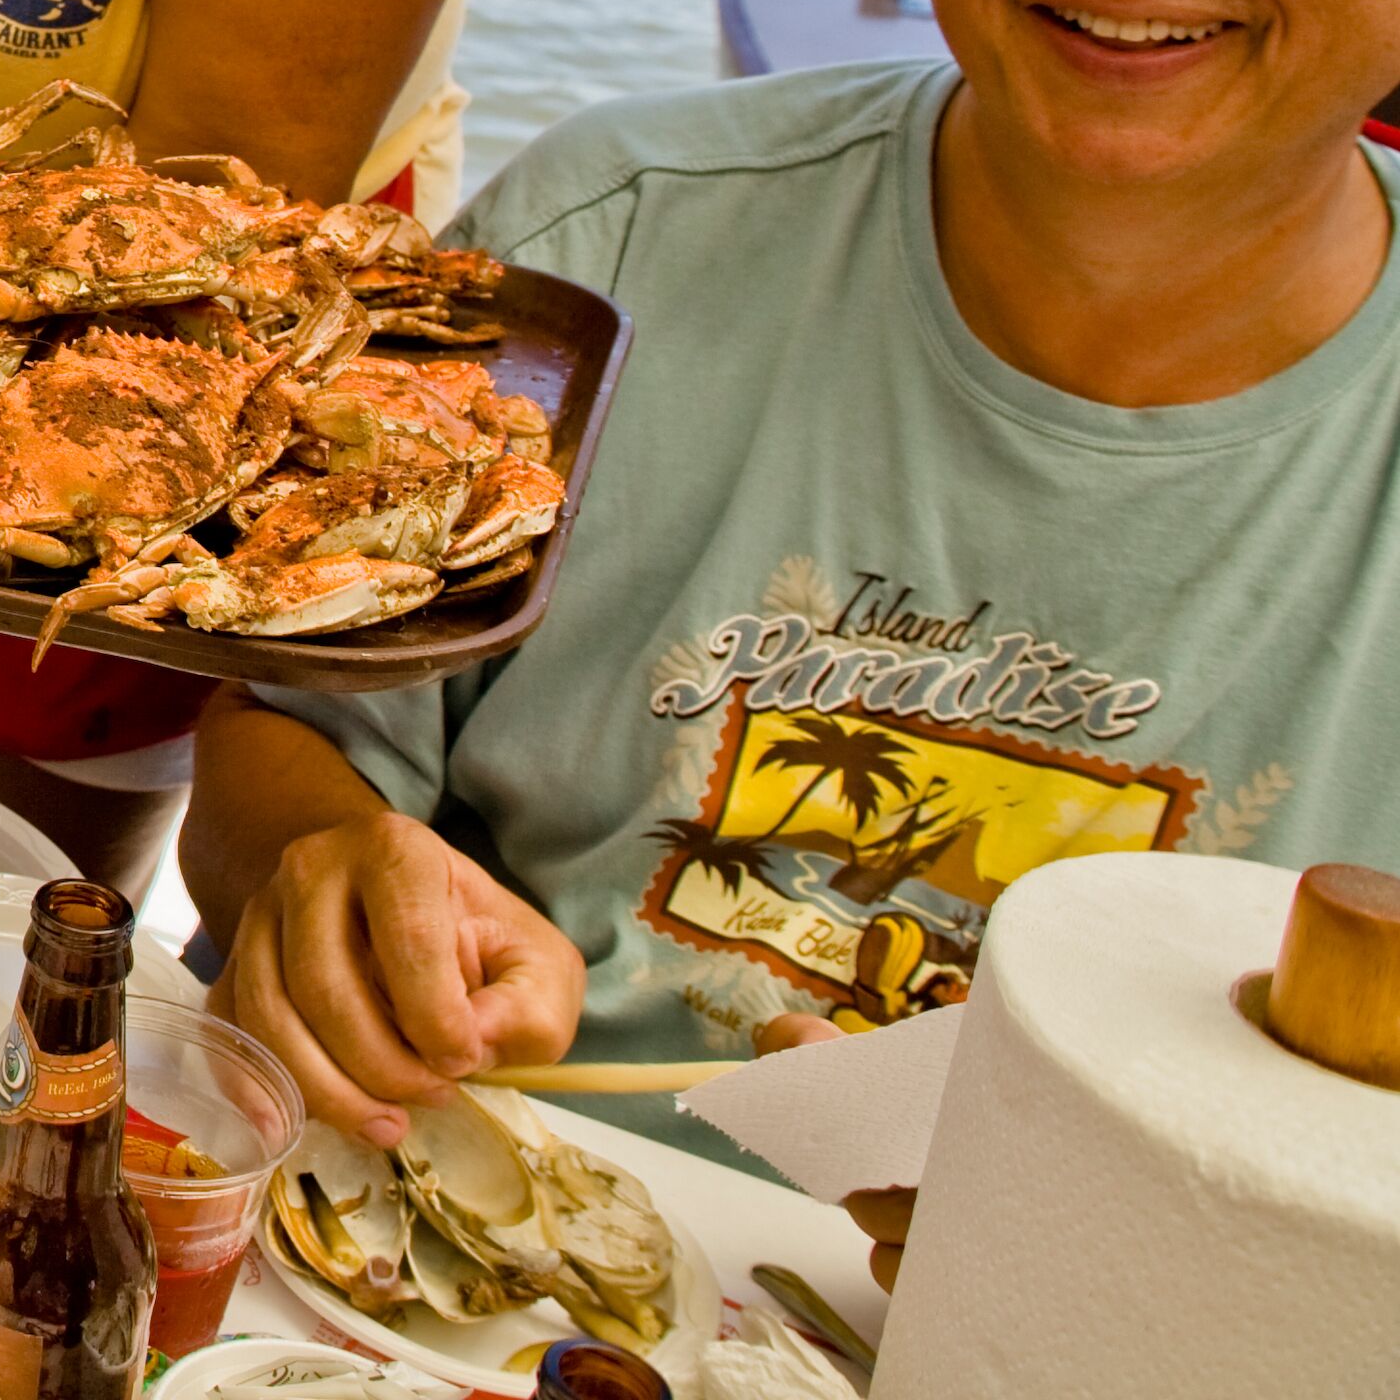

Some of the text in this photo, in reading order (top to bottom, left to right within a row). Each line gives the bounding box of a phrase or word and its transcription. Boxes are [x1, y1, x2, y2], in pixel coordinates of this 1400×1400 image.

[816, 570, 993, 654] Island
[649, 614, 1162, 739] Paradise
[48, 1082, 89, 1096] ReEst.
